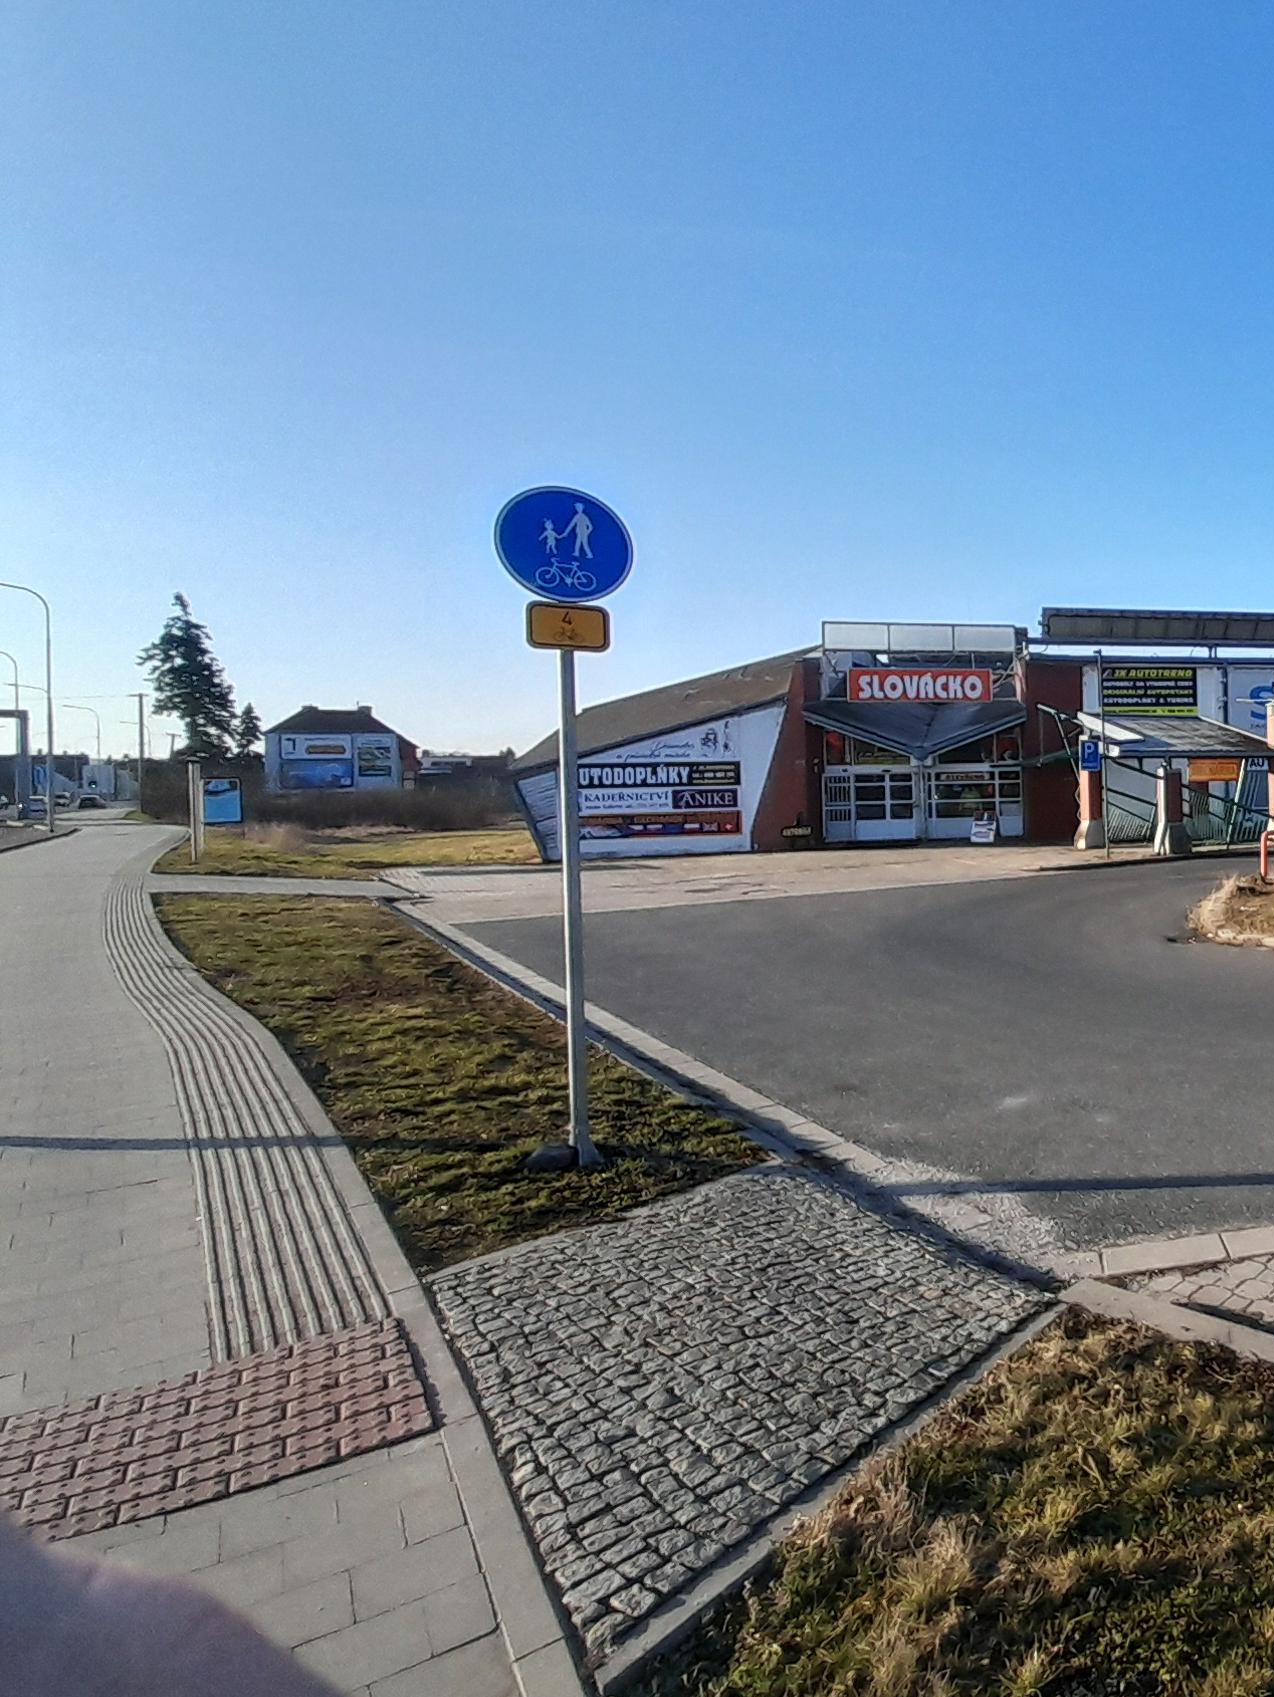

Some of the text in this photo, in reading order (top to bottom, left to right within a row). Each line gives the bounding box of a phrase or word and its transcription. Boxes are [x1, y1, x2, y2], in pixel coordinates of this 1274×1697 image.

[561, 611, 572, 626] 4
[858, 672, 983, 700] SLOVÁCKO
[1084, 742, 1095, 759] P
[578, 764, 690, 786] UTODOPLŇKY
[682, 791, 734, 807] ANIKE
